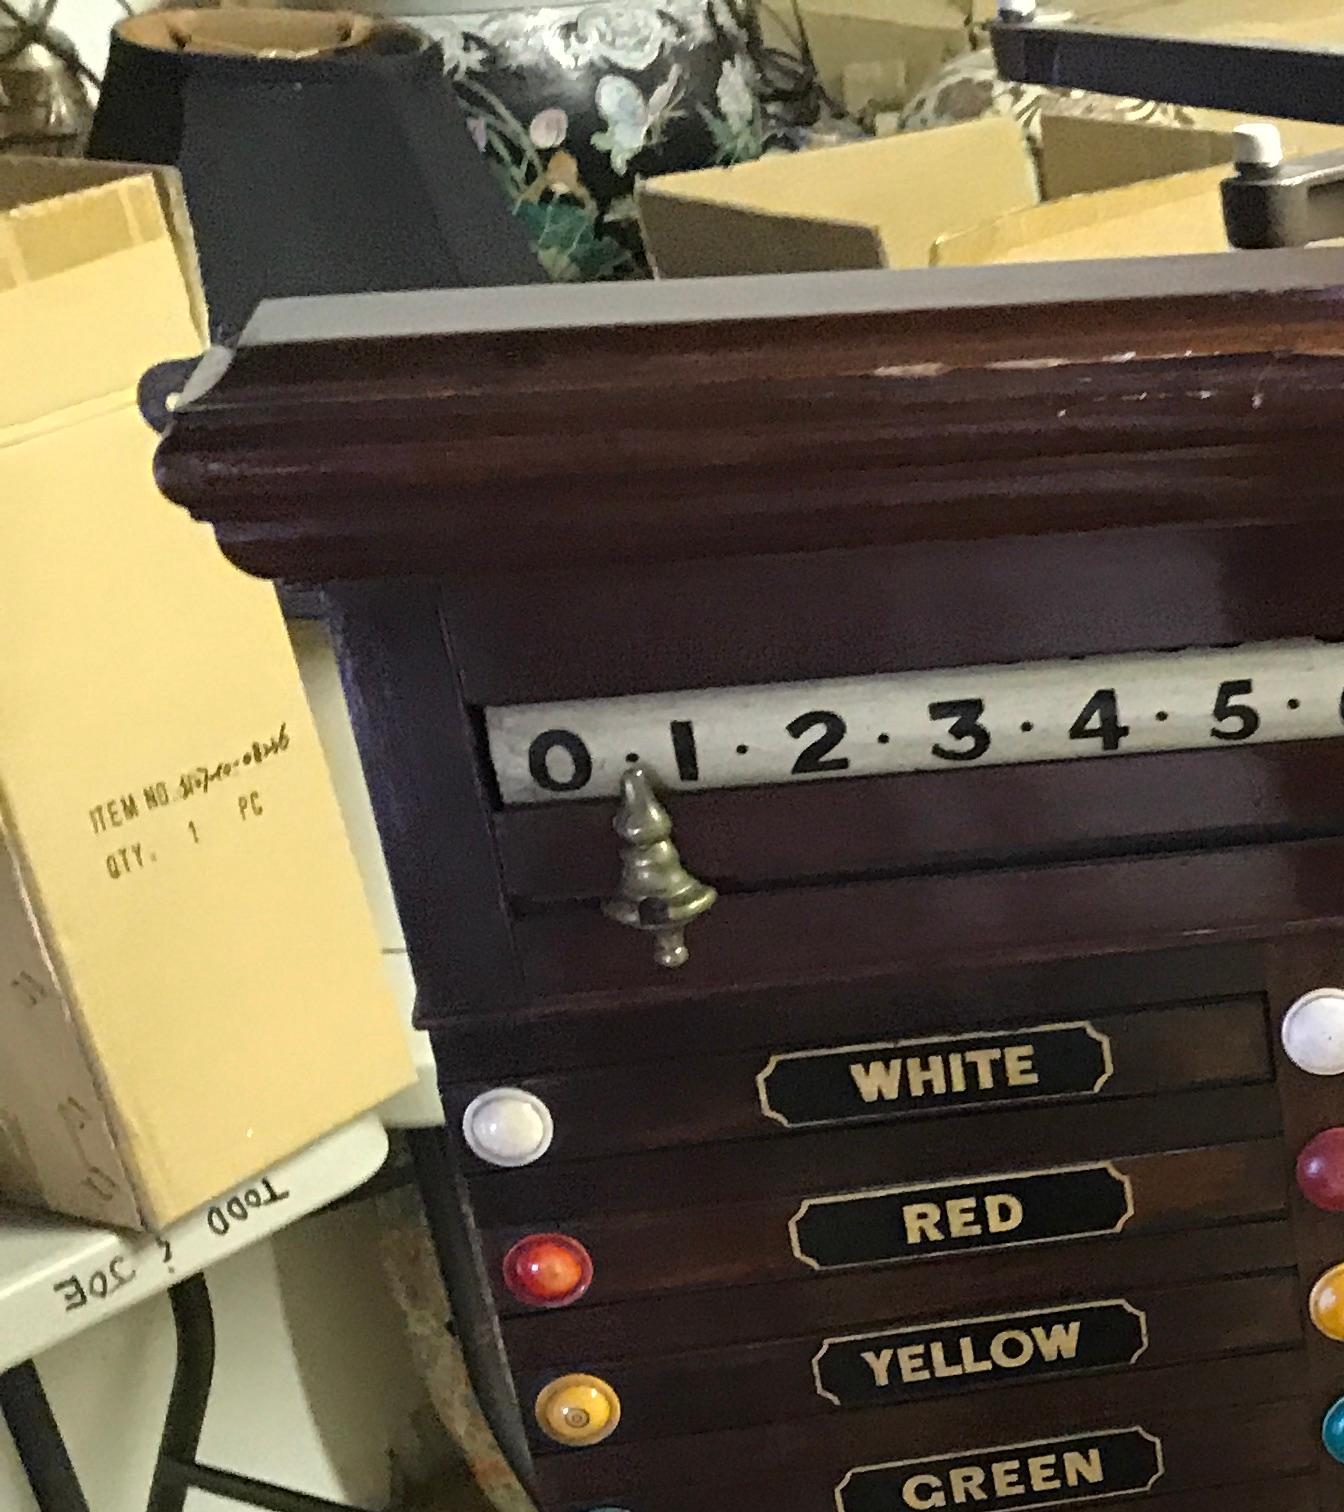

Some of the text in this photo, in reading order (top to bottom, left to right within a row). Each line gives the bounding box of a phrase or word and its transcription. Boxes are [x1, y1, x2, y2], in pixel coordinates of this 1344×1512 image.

[528, 728, 593, 792] 0
[670, 720, 699, 781] 1
[785, 710, 849, 773] 2
[928, 698, 991, 761] 3
[1069, 688, 1129, 751] 4
[1210, 678, 1260, 741] 5
[89, 792, 139, 835] ITEM
[188, 820, 199, 844] 1
[238, 790, 264, 821] PC
[850, 1044, 1040, 1103] WHITE
[207, 1176, 290, 1236] TODD
[902, 1193, 1024, 1245] RED
[53, 1255, 136, 1312] JOE
[860, 1321, 1082, 1387] YELLOW
[901, 1447, 1104, 1512] GREEN
